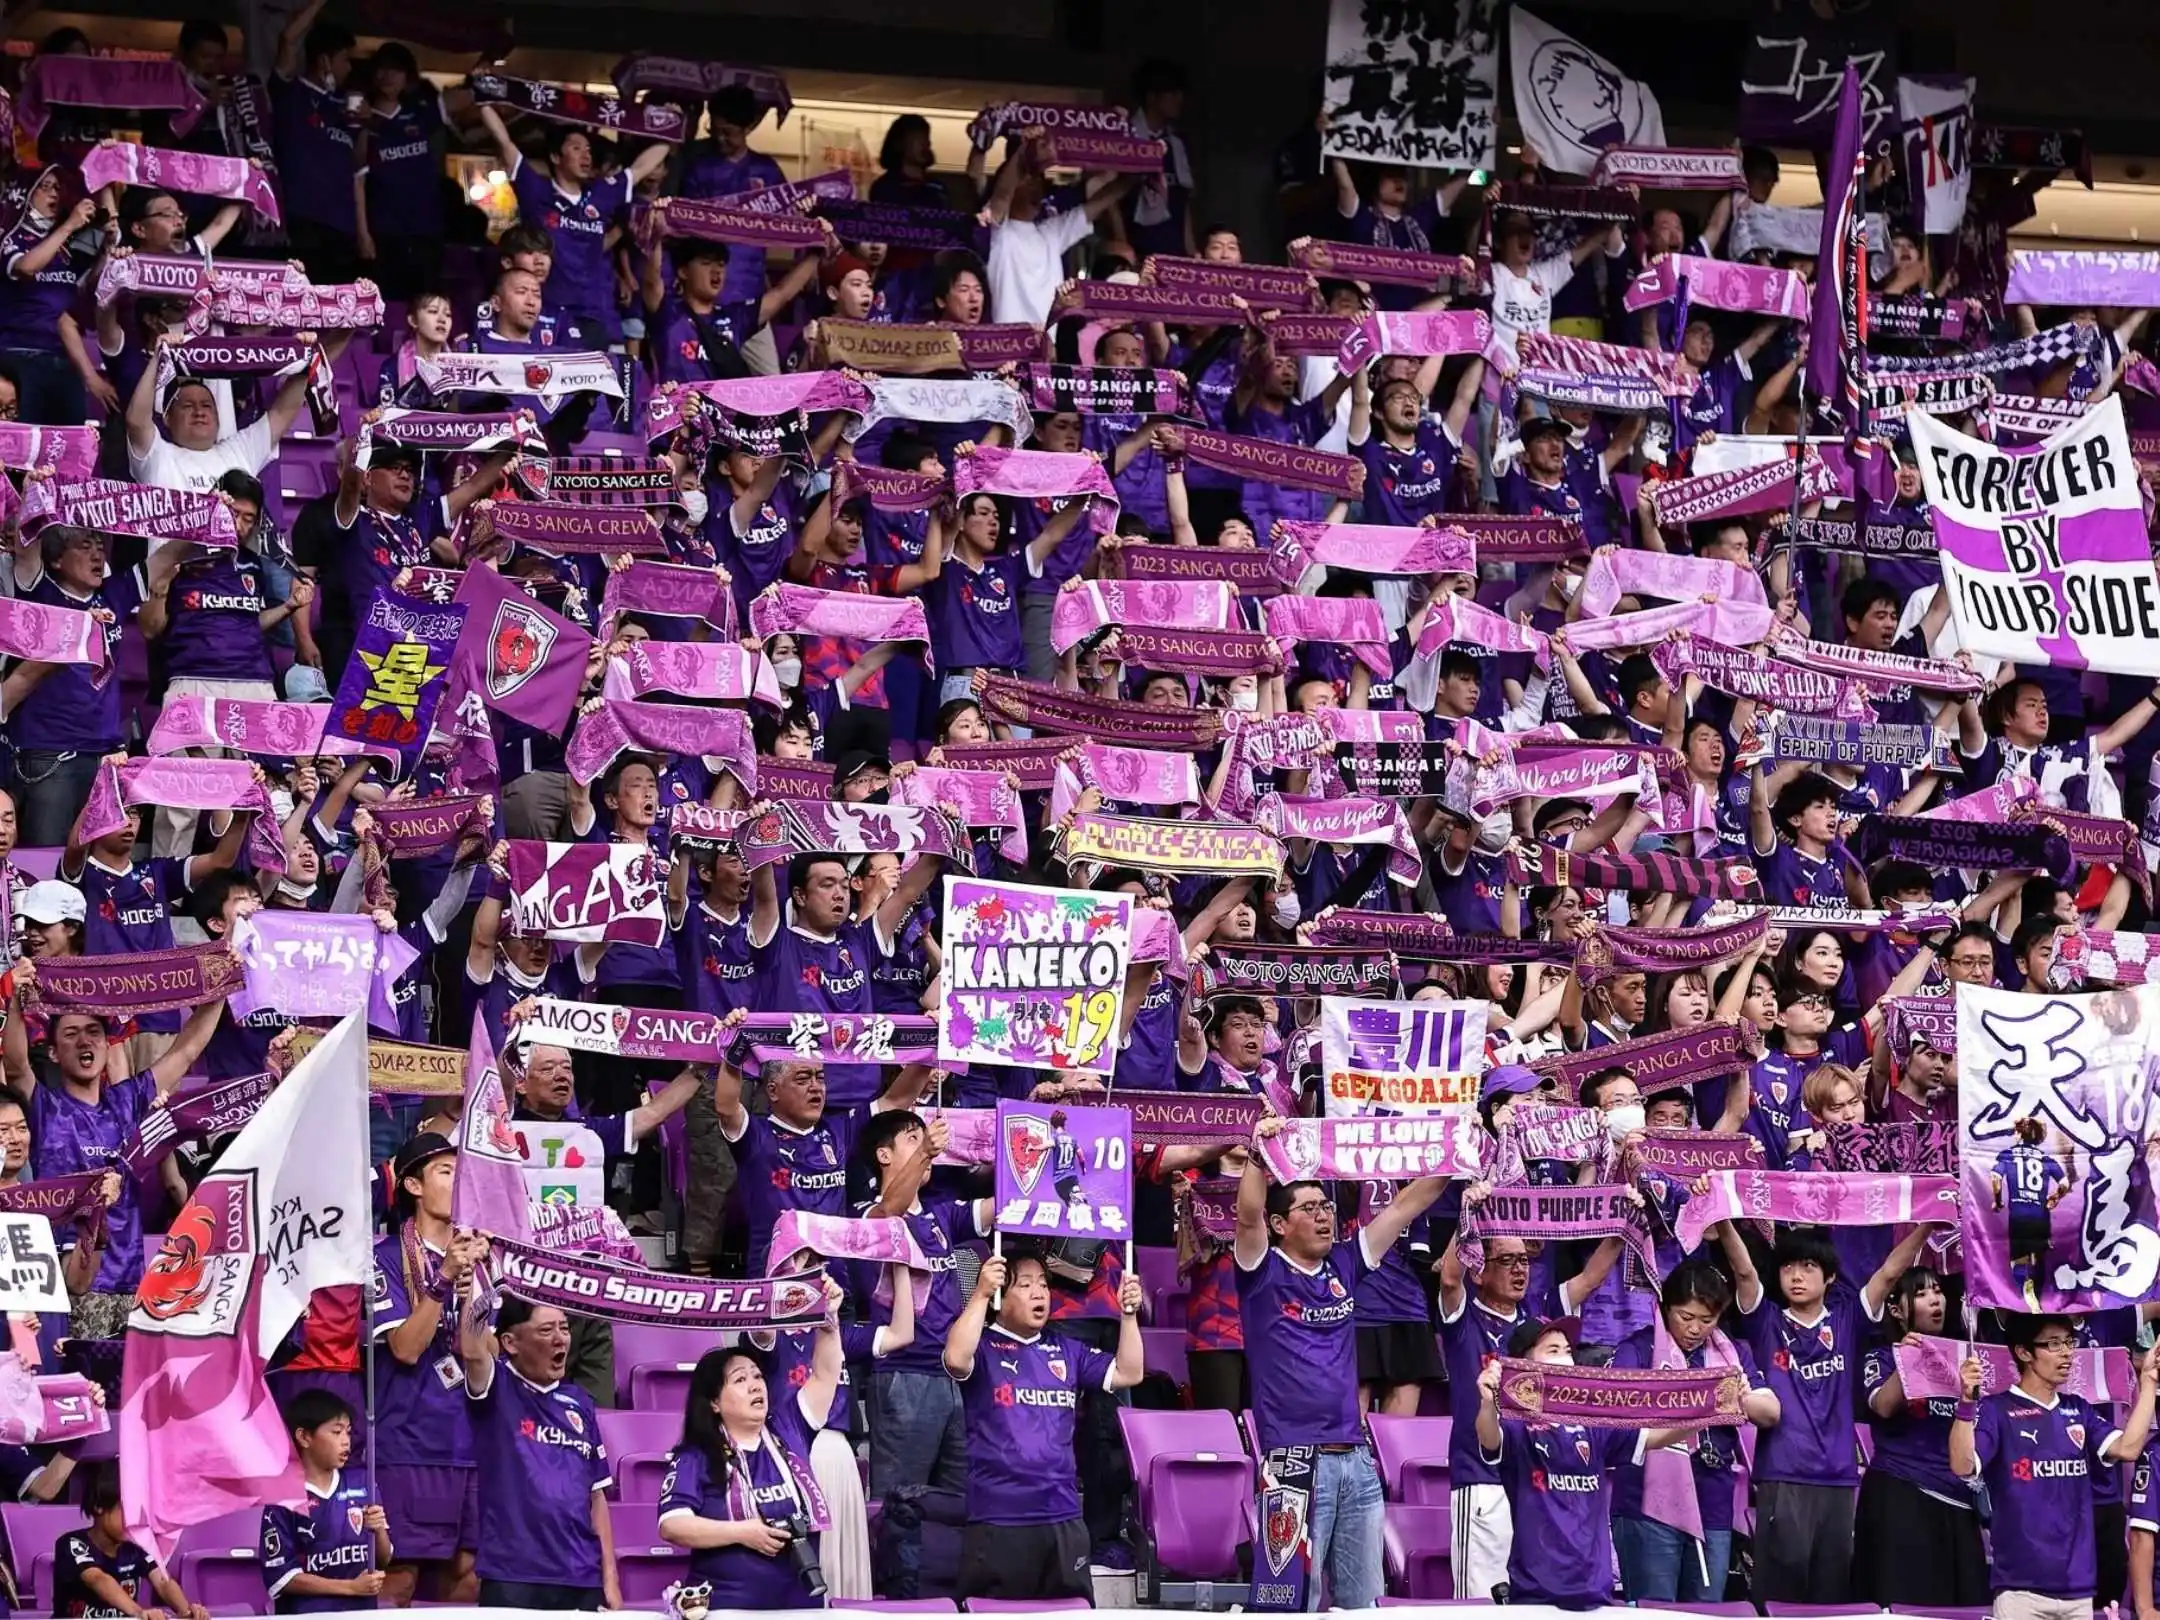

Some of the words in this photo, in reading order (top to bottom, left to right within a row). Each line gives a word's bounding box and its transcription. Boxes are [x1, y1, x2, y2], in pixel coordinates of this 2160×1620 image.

[1057, 137, 1087, 151] 2023
[1089, 138, 1134, 157] SANGA
[1609, 154, 1657, 174] KYOTO
[1661, 156, 1711, 174] SANGA
[670, 206, 706, 223] 2023
[709, 210, 765, 231] SANGA
[768, 215, 818, 235] CREW
[144, 261, 198, 287] KYOTO
[1160, 266, 1196, 283] 2023
[1199, 270, 1256, 289] SANGA
[1259, 275, 1308, 296] CREW
[1090, 285, 1130, 301] 2023
[1132, 288, 1195, 305] SANGA
[1876, 301, 1928, 320] SANGA
[969, 338, 1021, 354] SANGA
[1269, 326, 1304, 341] 2023
[173, 346, 232, 364] KYOTO
[236, 347, 297, 364] SANGA
[560, 374, 596, 385] KYOTO
[1036, 376, 1087, 393] KYOTO
[1090, 378, 1141, 394] SANGA
[1147, 379, 1173, 394] F.C.
[1548, 379, 1589, 400] Locos
[1592, 381, 1615, 401] Por
[908, 387, 971, 406] SANGA
[385, 419, 433, 438] KYOTO
[434, 423, 486, 438] SANGA
[1191, 433, 1227, 451] 2023
[1231, 442, 1289, 464] SANGA
[1292, 456, 1343, 478] CREW
[553, 475, 599, 488] KYOTO
[601, 474, 648, 489] SANGA
[649, 474, 672, 487] F.C.
[867, 477, 918, 497] SANGA
[1931, 434, 2118, 514] FOREVER
[60, 482, 85, 501] PRIDE
[86, 481, 97, 498] OF
[64, 499, 118, 528] KYOTO
[121, 494, 176, 523] SANGA
[180, 489, 209, 511] F.C.
[134, 521, 152, 537] WE
[154, 518, 181, 534] LOVE
[182, 509, 209, 531] KYOTO
[495, 508, 531, 529] 2023
[535, 512, 594, 534] SANGA
[598, 518, 650, 536] CREW
[1474, 527, 1532, 546] SANGA
[2001, 519, 2061, 574] BY
[1131, 554, 1166, 573] 2023
[1170, 559, 1227, 577] SANGA
[2067, 574, 2160, 639] SIDE
[368, 600, 462, 641] 京都の歴史に
[1162, 638, 1218, 657] SANGA
[364, 641, 430, 707] 星
[1734, 671, 1782, 697] SANGA
[1787, 672, 1837, 699] KYOTO
[339, 706, 419, 746] を刻め
[1034, 701, 1069, 718] 2023
[1076, 710, 1135, 730] SANGA
[1777, 715, 1846, 739] KYOTO
[1858, 724, 1926, 746] SANGA
[984, 756, 1046, 772] SANGA
[1780, 737, 1834, 760] SPIRIT
[1837, 742, 1857, 762] OF
[1862, 746, 1926, 766] PURPLE
[1372, 757, 1428, 773] SANGA
[1520, 767, 1547, 790] We
[1551, 767, 1577, 782] are
[1582, 752, 1631, 784] kyoto
[769, 777, 822, 798] SANGA
[388, 816, 450, 838] SANGA
[1288, 812, 1312, 835] We
[1313, 812, 1339, 832] are
[1342, 804, 1386, 830] kyoto
[1084, 821, 1178, 856] PURPLE
[1181, 831, 1263, 861] SANGA
[2070, 826, 2112, 846] SANGA
[161, 968, 196, 988] 2023
[951, 942, 1119, 990] KANEKO
[1223, 956, 1282, 984] KYOTO
[1289, 963, 1354, 984] SANGA
[102, 974, 158, 994] SANGA
[636, 1016, 718, 1044] SANGA
[786, 1013, 897, 1061] 紫魂
[1064, 991, 1116, 1066] 19
[1347, 1008, 1466, 1072] 豊川
[1626, 1051, 1693, 1076] SANGA
[1135, 1104, 1197, 1126] SANGA
[1201, 1106, 1256, 1126] CREW
[1334, 1122, 1374, 1145] WE
[1378, 1120, 1444, 1144] LOVE
[1058, 1143, 1074, 1164] 10
[1093, 1137, 1125, 1170] 10
[1642, 1147, 1678, 1166] 2023
[1682, 1149, 1741, 1168] SANGA
[2014, 1157, 2044, 1192] 18
[14, 1188, 77, 1209] SANGA
[1366, 1180, 1392, 1206] 23
[227, 1183, 244, 1252] KYOTO
[1475, 1196, 1532, 1222] KYOTO
[1538, 1197, 1603, 1223] PURPLE
[209, 1256, 241, 1326] SANGA
[500, 1252, 600, 1298] Kyoto
[603, 1277, 704, 1313] Sanga
[710, 1286, 767, 1314] F.C.
[1548, 1388, 1591, 1406] 2023
[1593, 1390, 1653, 1408] SANGA
[1656, 1390, 1709, 1409] CREW
